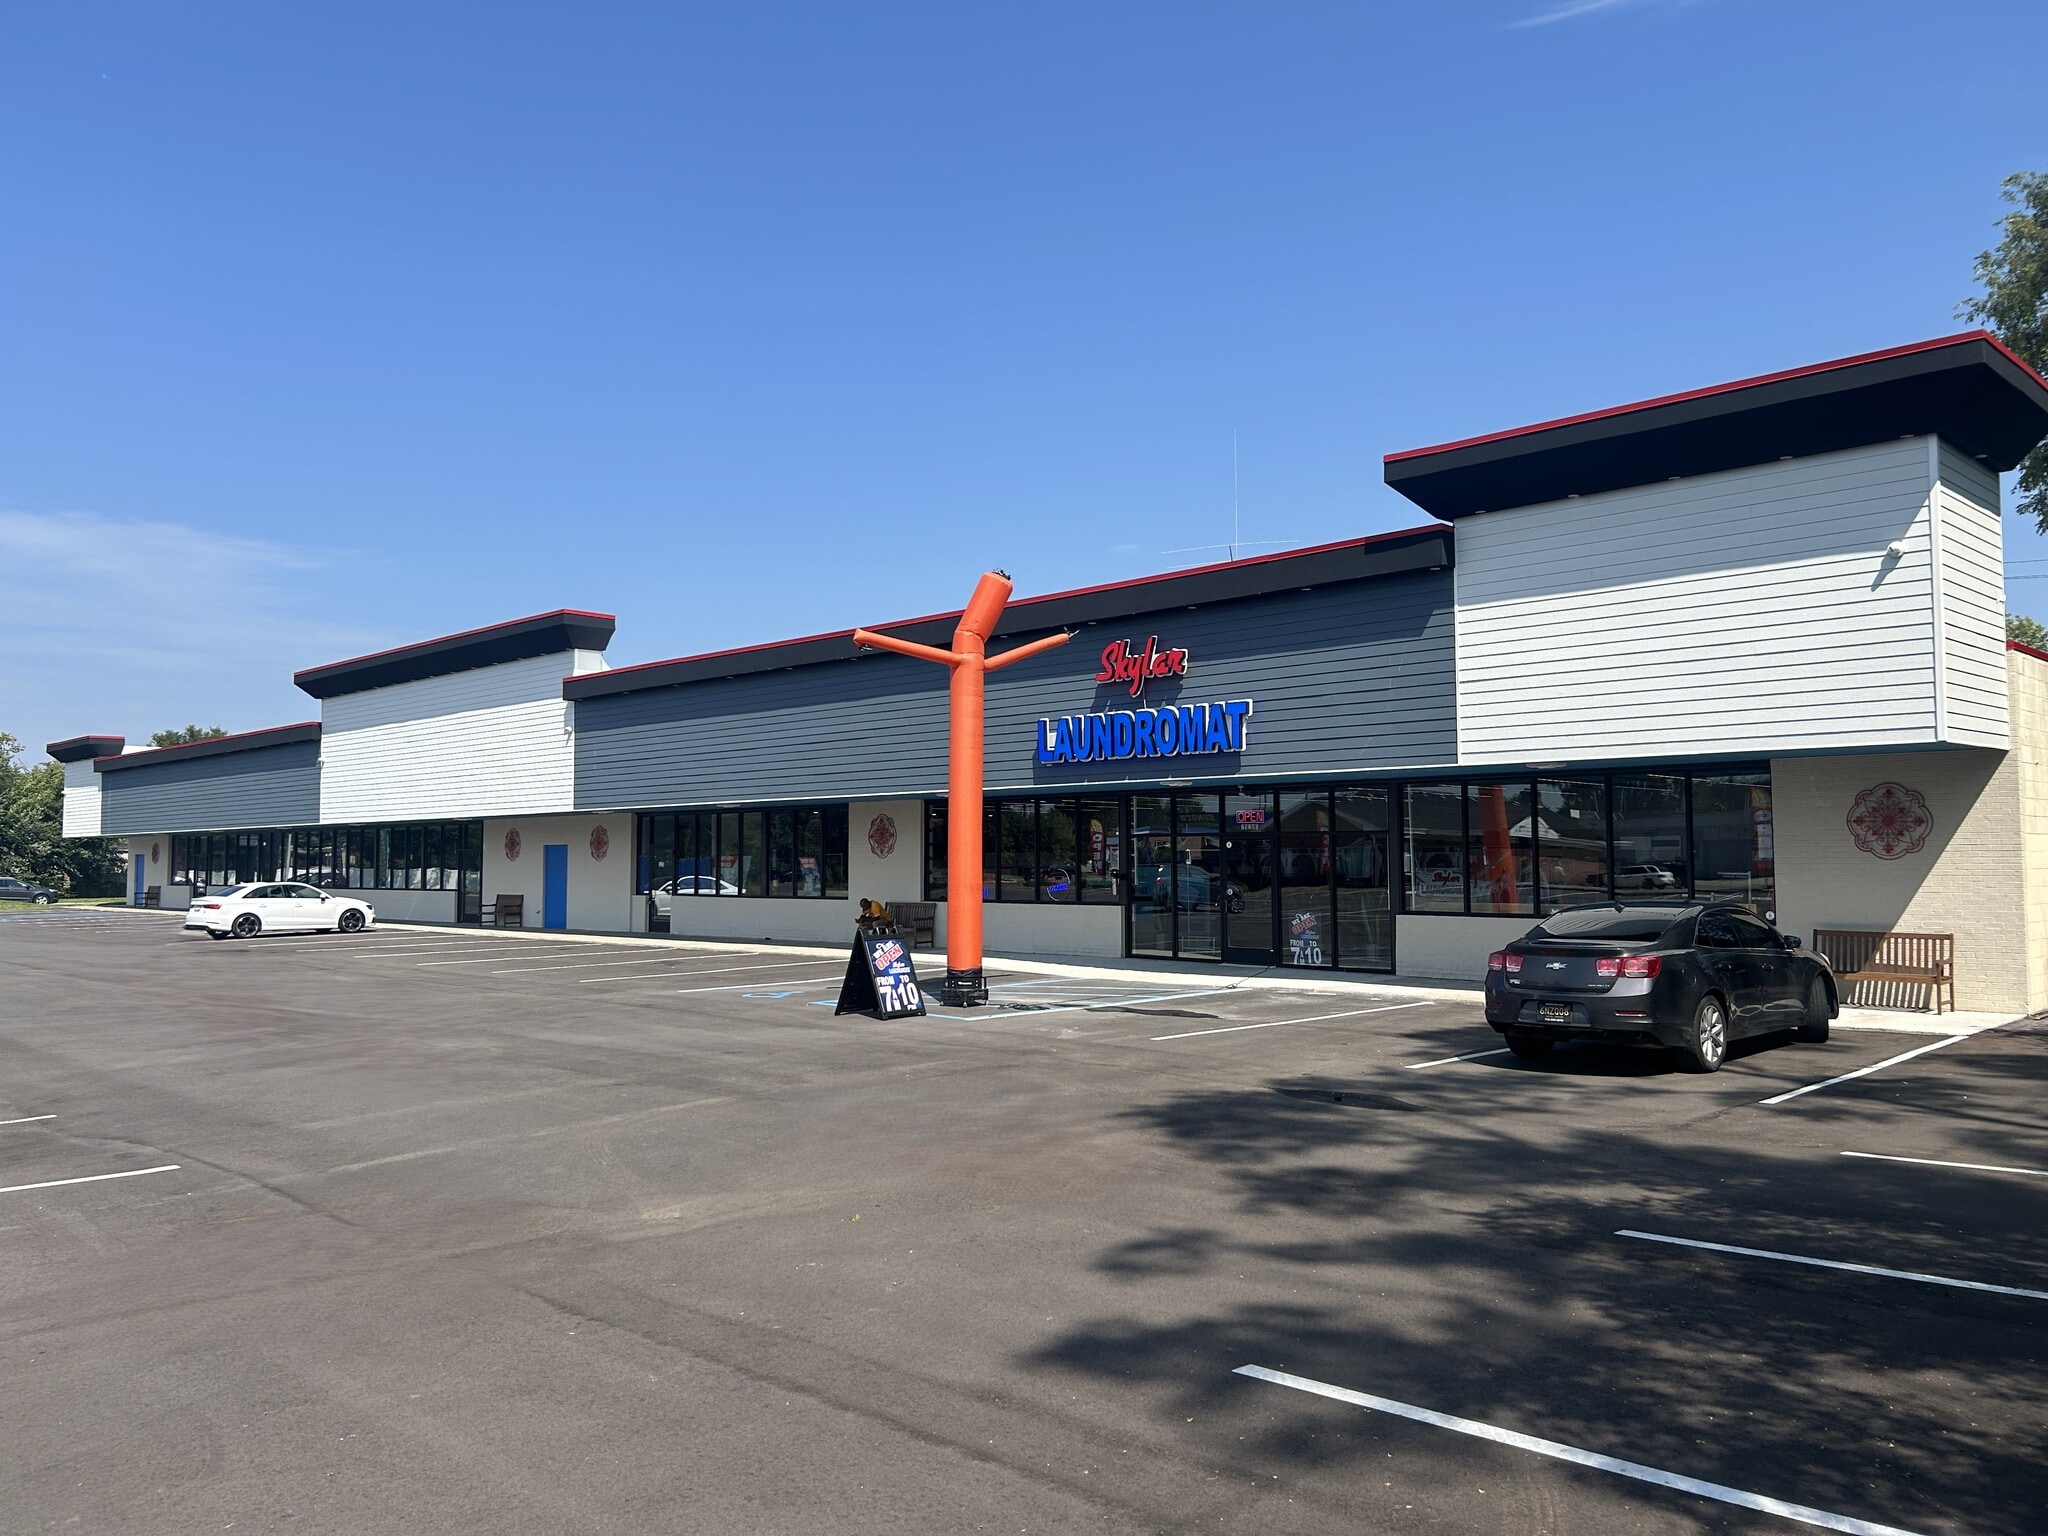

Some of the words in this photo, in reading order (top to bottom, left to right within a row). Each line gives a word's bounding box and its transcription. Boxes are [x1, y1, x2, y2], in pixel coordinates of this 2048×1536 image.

[1095, 635, 1188, 697] Skylar
[1038, 698, 1253, 763] LAUNDROMAT
[1237, 811, 1263, 822] OPEN
[1292, 916, 1317, 934] OPEN
[1290, 939, 1304, 947] FROM
[875, 943, 904, 971] OPEN
[1290, 947, 1300, 964] 7
[1305, 947, 1322, 964] 10
[876, 975, 895, 986] FROM
[879, 985, 893, 1012] 7
[897, 982, 920, 1006] 10
